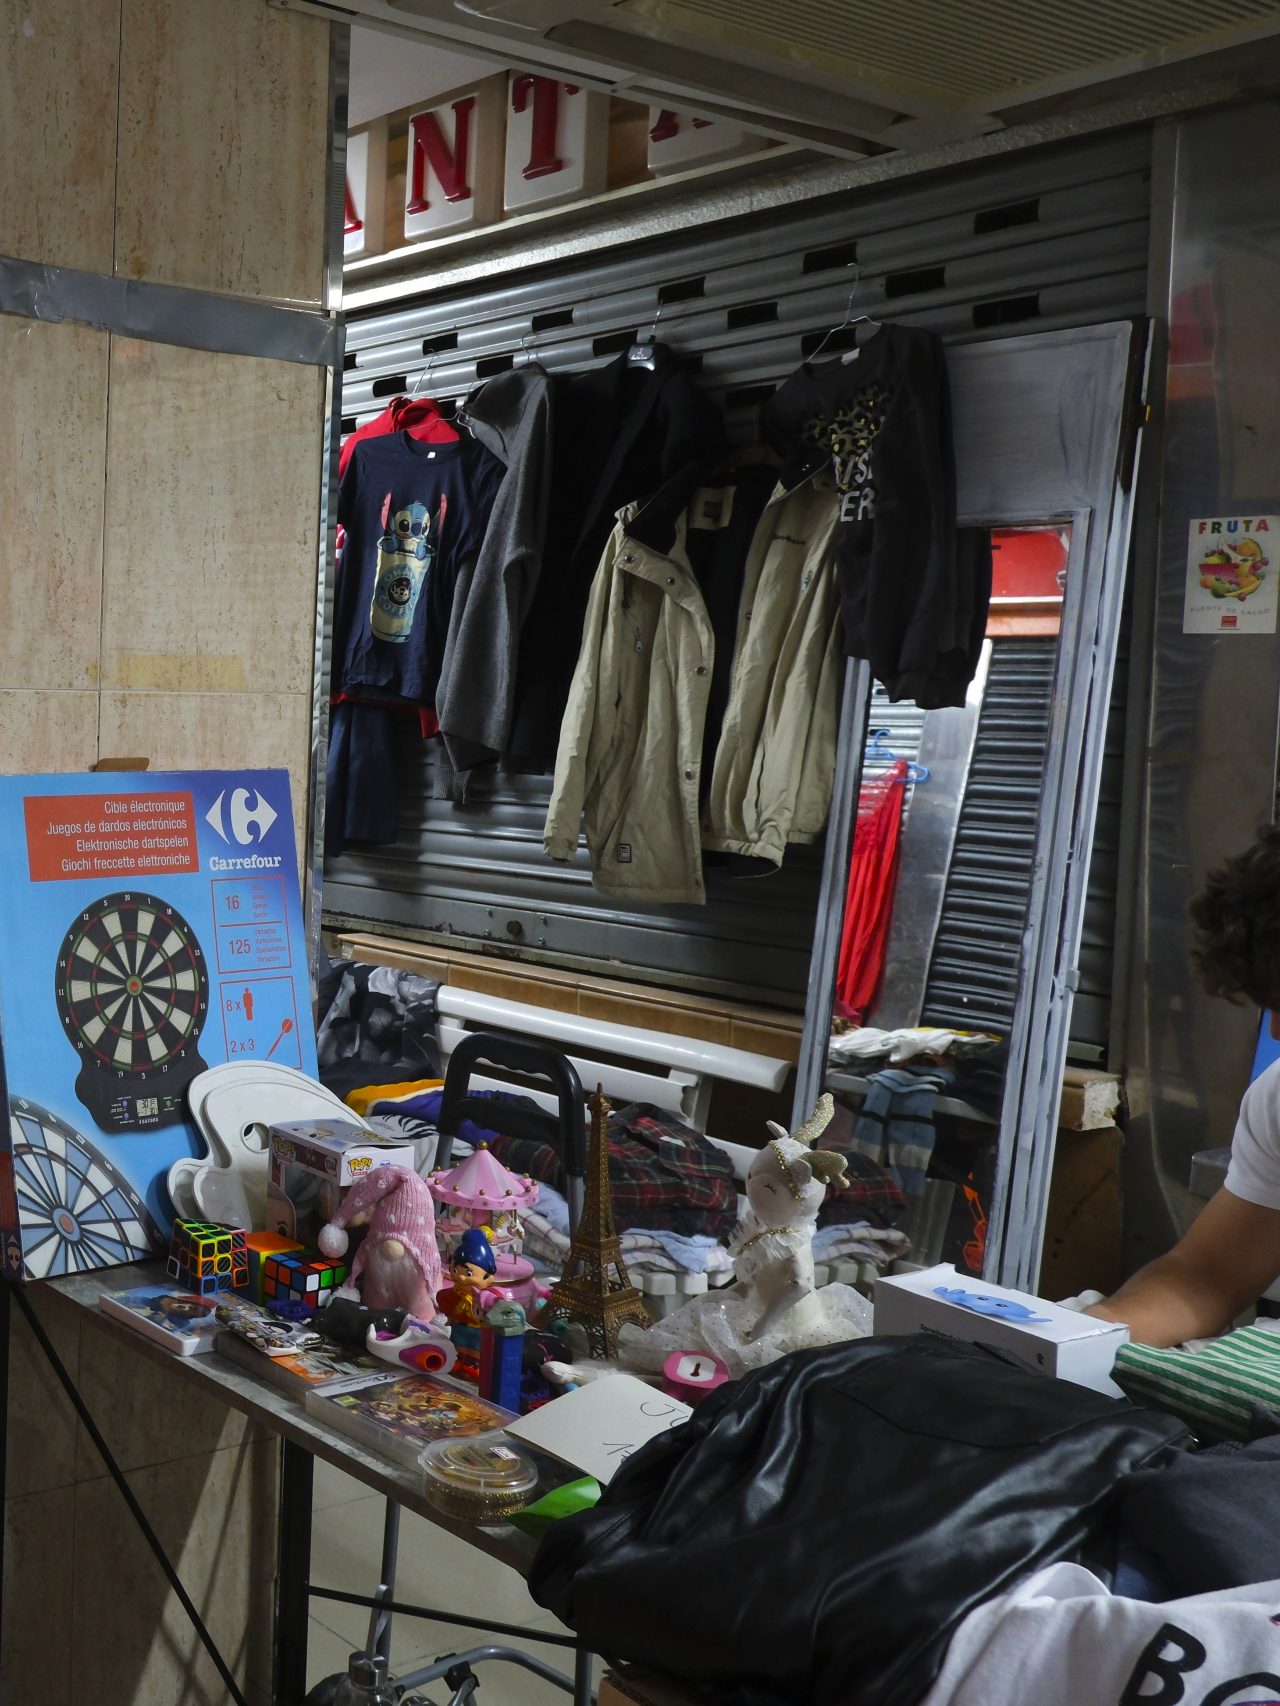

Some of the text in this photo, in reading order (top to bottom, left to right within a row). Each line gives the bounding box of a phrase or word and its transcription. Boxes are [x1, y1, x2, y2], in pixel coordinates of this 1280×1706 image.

[1198, 518, 1270, 534] FRUTA
[104, 799, 185, 814] Cible électronique
[47, 818, 187, 836] Juegos de dardos electrónicos
[76, 836, 189, 852] Elektronische dartspelen
[61, 854, 190, 872] Giochi freccette elettroniche
[208, 854, 282, 870] Carrefour
[225, 895, 240, 911] 16
[228, 938, 251, 955] 125
[226, 1000, 242, 1011] 8 x
[230, 1039, 255, 1053] 2 x 3
[347, 1157, 373, 1171] POP!
